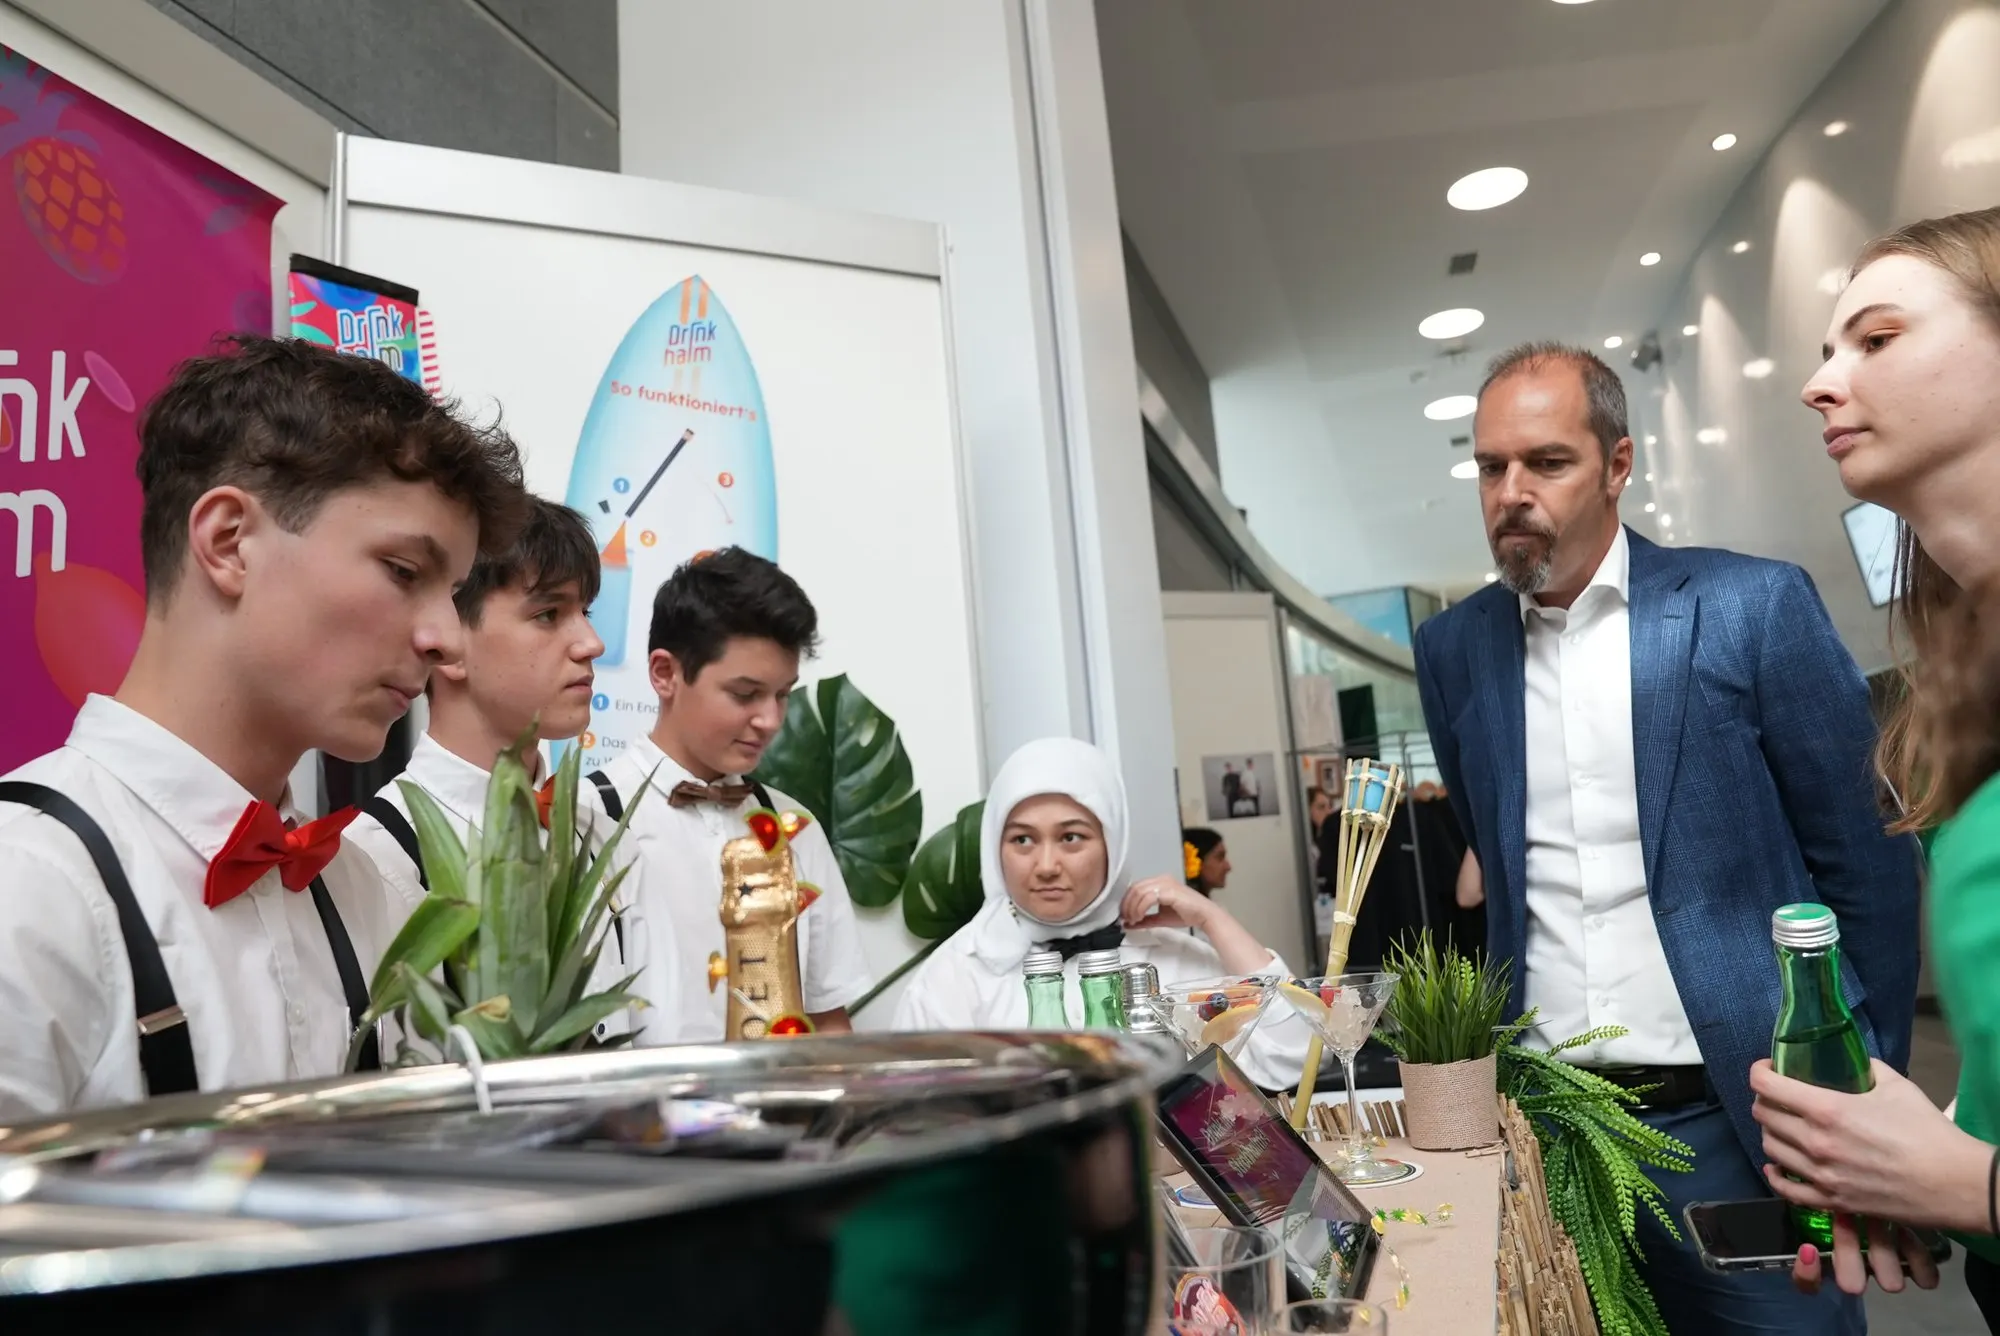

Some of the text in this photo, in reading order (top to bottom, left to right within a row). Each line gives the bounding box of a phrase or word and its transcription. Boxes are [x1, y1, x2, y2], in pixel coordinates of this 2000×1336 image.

[337, 305, 404, 346] Drink
[668, 320, 717, 345] Drink
[664, 346, 711, 366] halm
[0, 350, 90, 462] nk
[611, 380, 757, 421] So funktioniert's
[615, 699, 633, 711] Ein
[601, 736, 627, 749] Das
